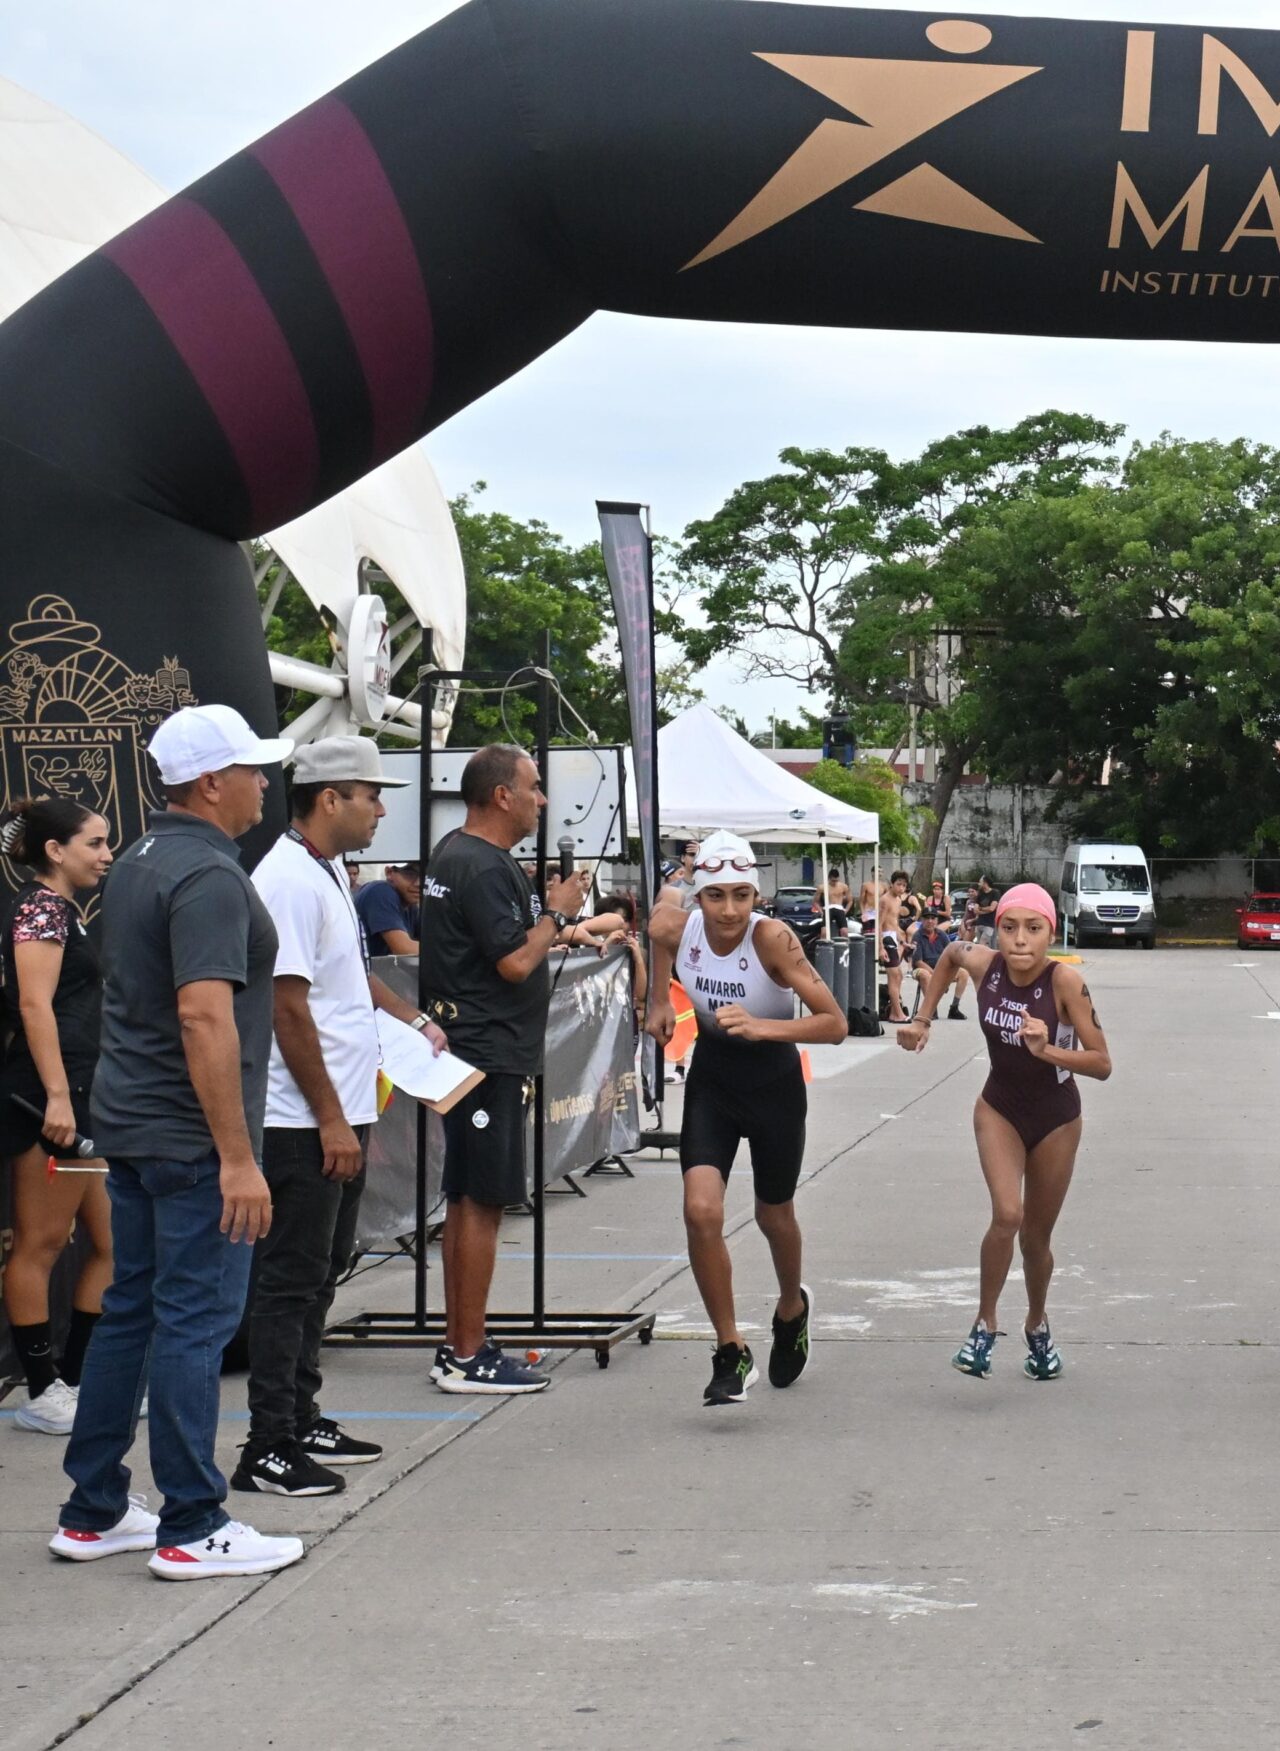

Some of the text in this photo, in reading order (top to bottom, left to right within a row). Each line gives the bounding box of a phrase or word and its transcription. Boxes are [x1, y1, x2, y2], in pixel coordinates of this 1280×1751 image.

[12, 728, 122, 743] MAZATLAN
[695, 976, 746, 998] NAVARRO
[984, 1006, 1023, 1031] ALVAR
[1000, 1030, 1022, 1047] SIN
